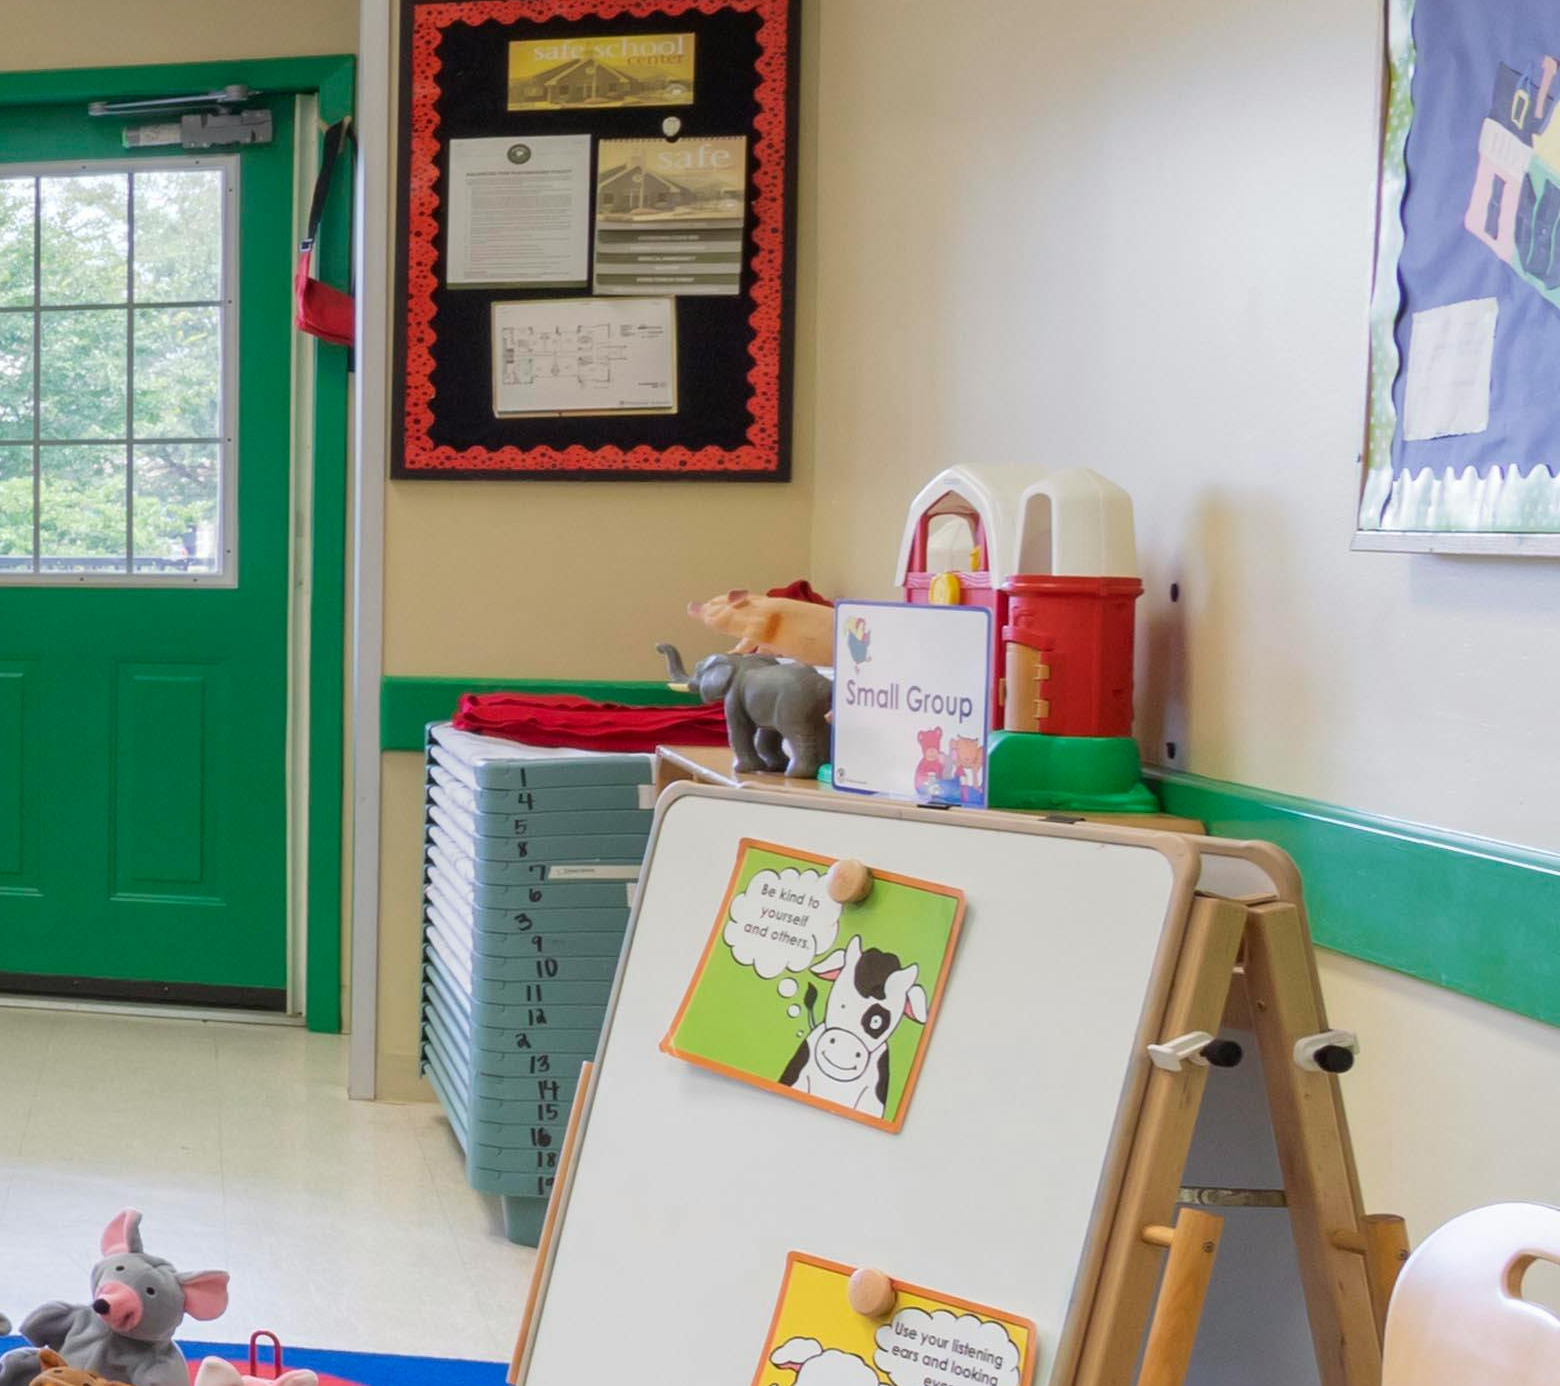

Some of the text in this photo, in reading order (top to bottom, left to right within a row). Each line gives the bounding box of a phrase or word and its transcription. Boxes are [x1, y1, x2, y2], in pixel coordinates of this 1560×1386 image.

[533, 36, 685, 61] safe school
[627, 53, 684, 64] center
[656, 144, 729, 169] safe
[846, 679, 973, 724] Small Group
[518, 793, 533, 810] 4
[514, 819, 527, 834] 5
[518, 842, 528, 858] 8
[529, 864, 546, 881] 7
[529, 888, 542, 903] 6
[761, 884, 820, 909] Be kind to
[515, 913, 533, 931] 3
[760, 905, 810, 927] yourself
[531, 936, 543, 952] 9
[744, 922, 810, 950] and others.
[536, 959, 558, 978] 10
[527, 984, 542, 1002] 11
[528, 1009, 547, 1026] 12
[516, 1033, 531, 1049] 2
[530, 1055, 551, 1073] 13
[538, 1080, 559, 1100] 14
[538, 1104, 558, 1121] 15
[537, 1151, 557, 1167] 18
[895, 1322, 1003, 1370] Use your listening
[891, 1345, 919, 1362] ears
[922, 1354, 949, 1371] and
